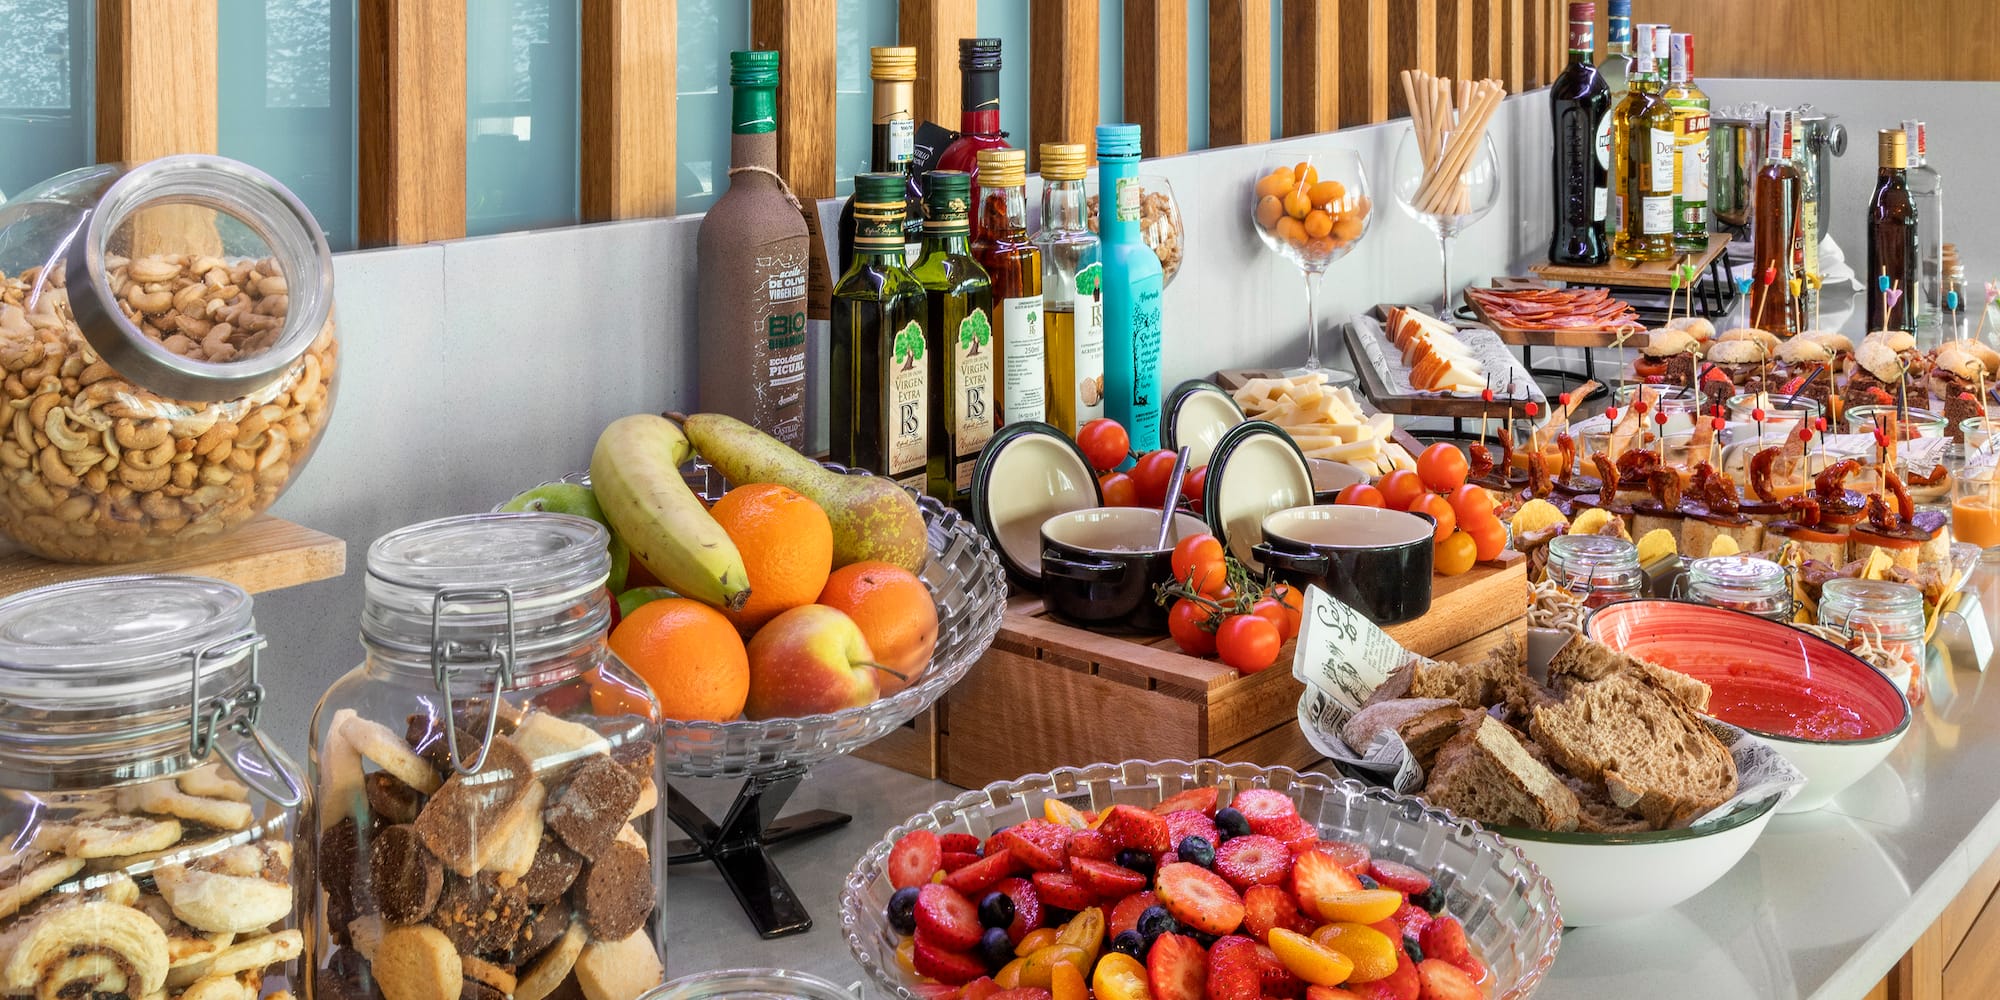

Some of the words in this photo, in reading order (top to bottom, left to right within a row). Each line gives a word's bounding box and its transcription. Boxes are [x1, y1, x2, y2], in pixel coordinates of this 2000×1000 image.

[768, 279, 783, 290] DE
[784, 275, 806, 287] OLIVA
[769, 287, 793, 302] VIRGEN
[769, 311, 806, 338] BIO
[769, 360, 806, 377] PICUAL
[961, 361, 990, 376] VIRGEN
[895, 376, 924, 391] VIRGEN
[964, 375, 988, 388] EXTRA
[898, 389, 921, 403] EXTRA
